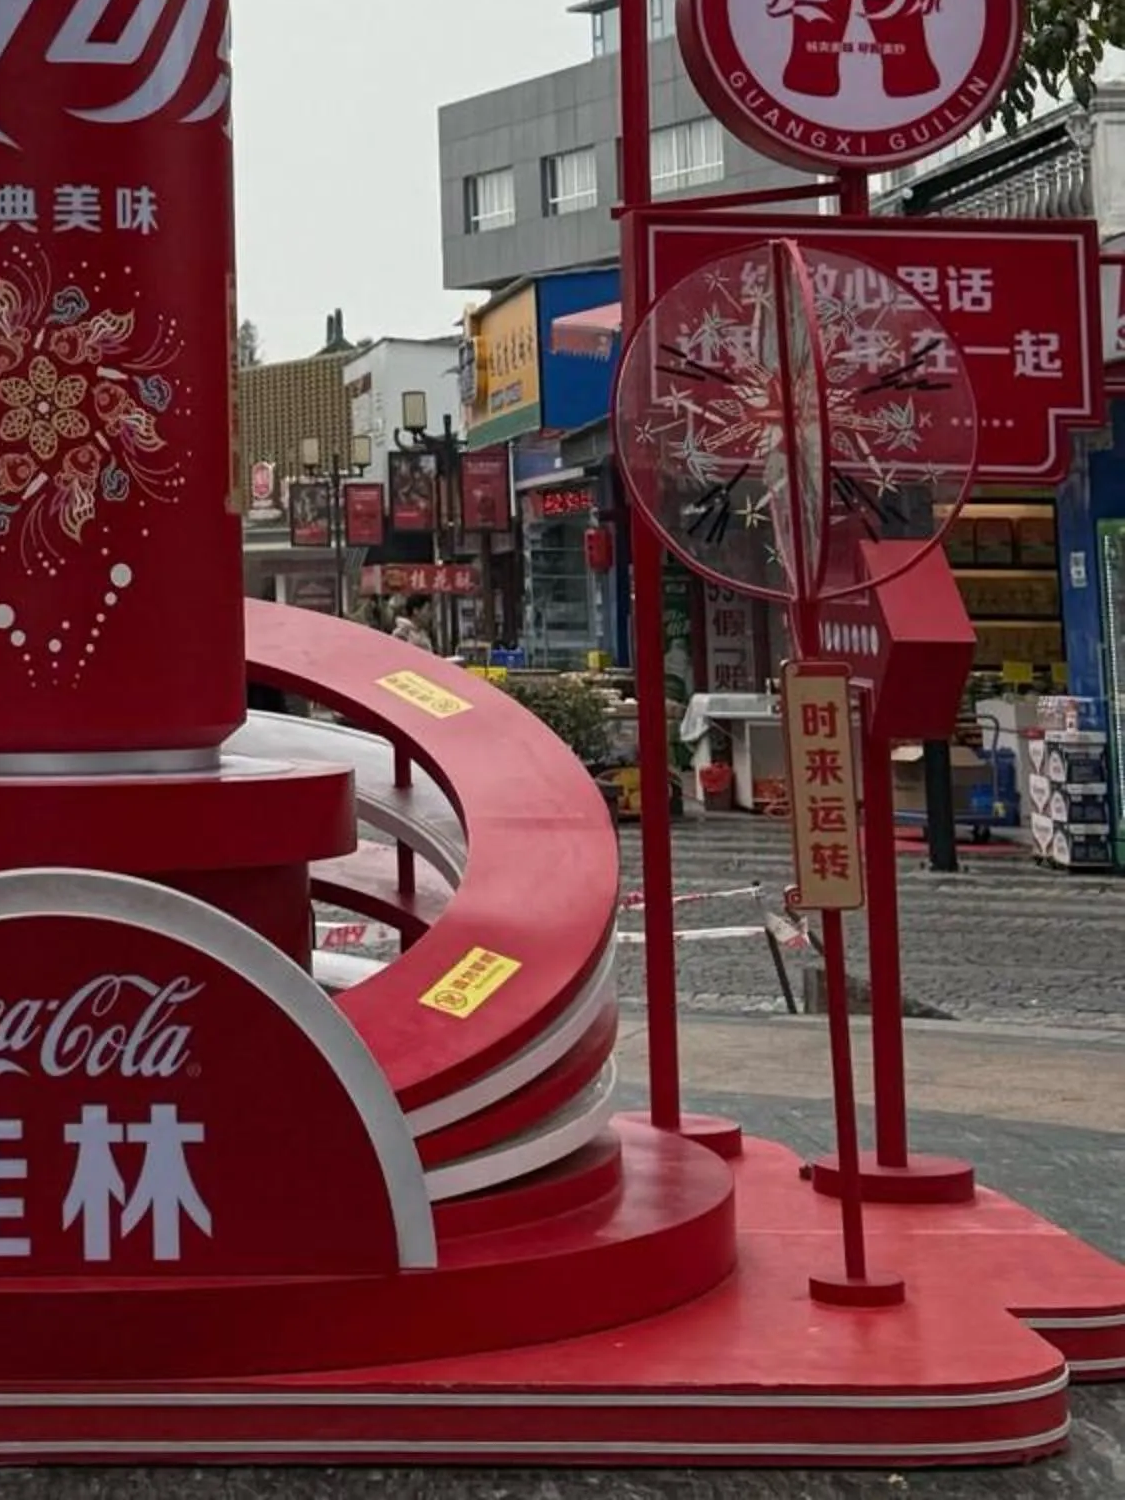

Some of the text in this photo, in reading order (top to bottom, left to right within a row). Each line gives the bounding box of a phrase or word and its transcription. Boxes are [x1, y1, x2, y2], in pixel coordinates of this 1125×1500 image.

[728, 70, 989, 155] GUANGXI GUILIN
[801, 702, 851, 881] 时来运转
